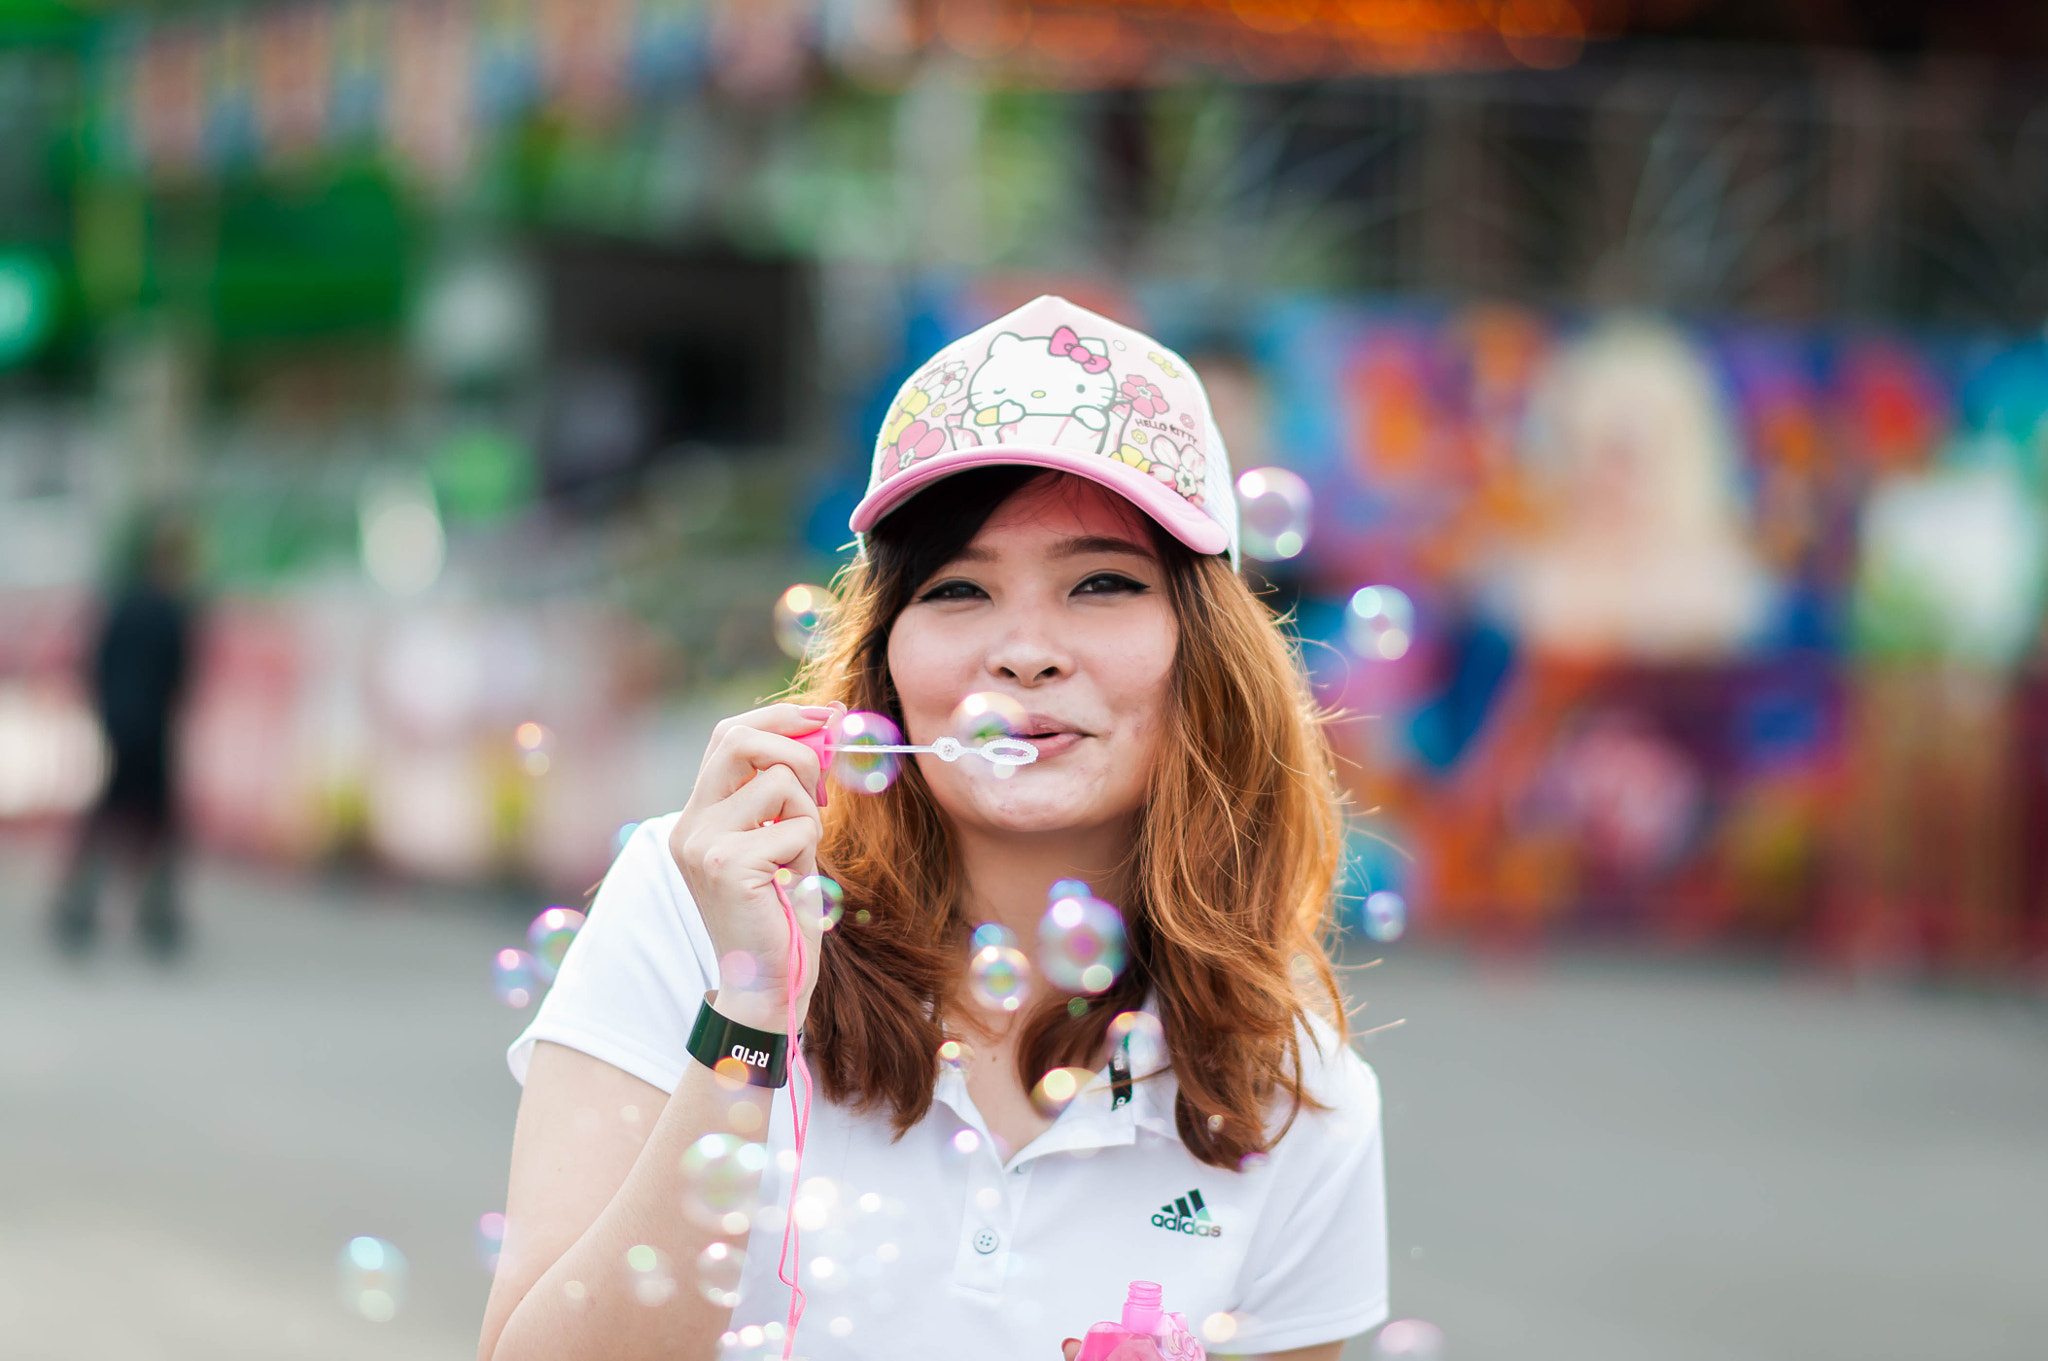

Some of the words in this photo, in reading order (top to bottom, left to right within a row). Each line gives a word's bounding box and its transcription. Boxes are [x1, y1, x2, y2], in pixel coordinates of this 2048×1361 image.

[1135, 418, 1167, 431] HELLO
[1169, 424, 1198, 444] KITTY
[731, 1044, 770, 1068] RFID
[1151, 1213, 1222, 1238] adidas
